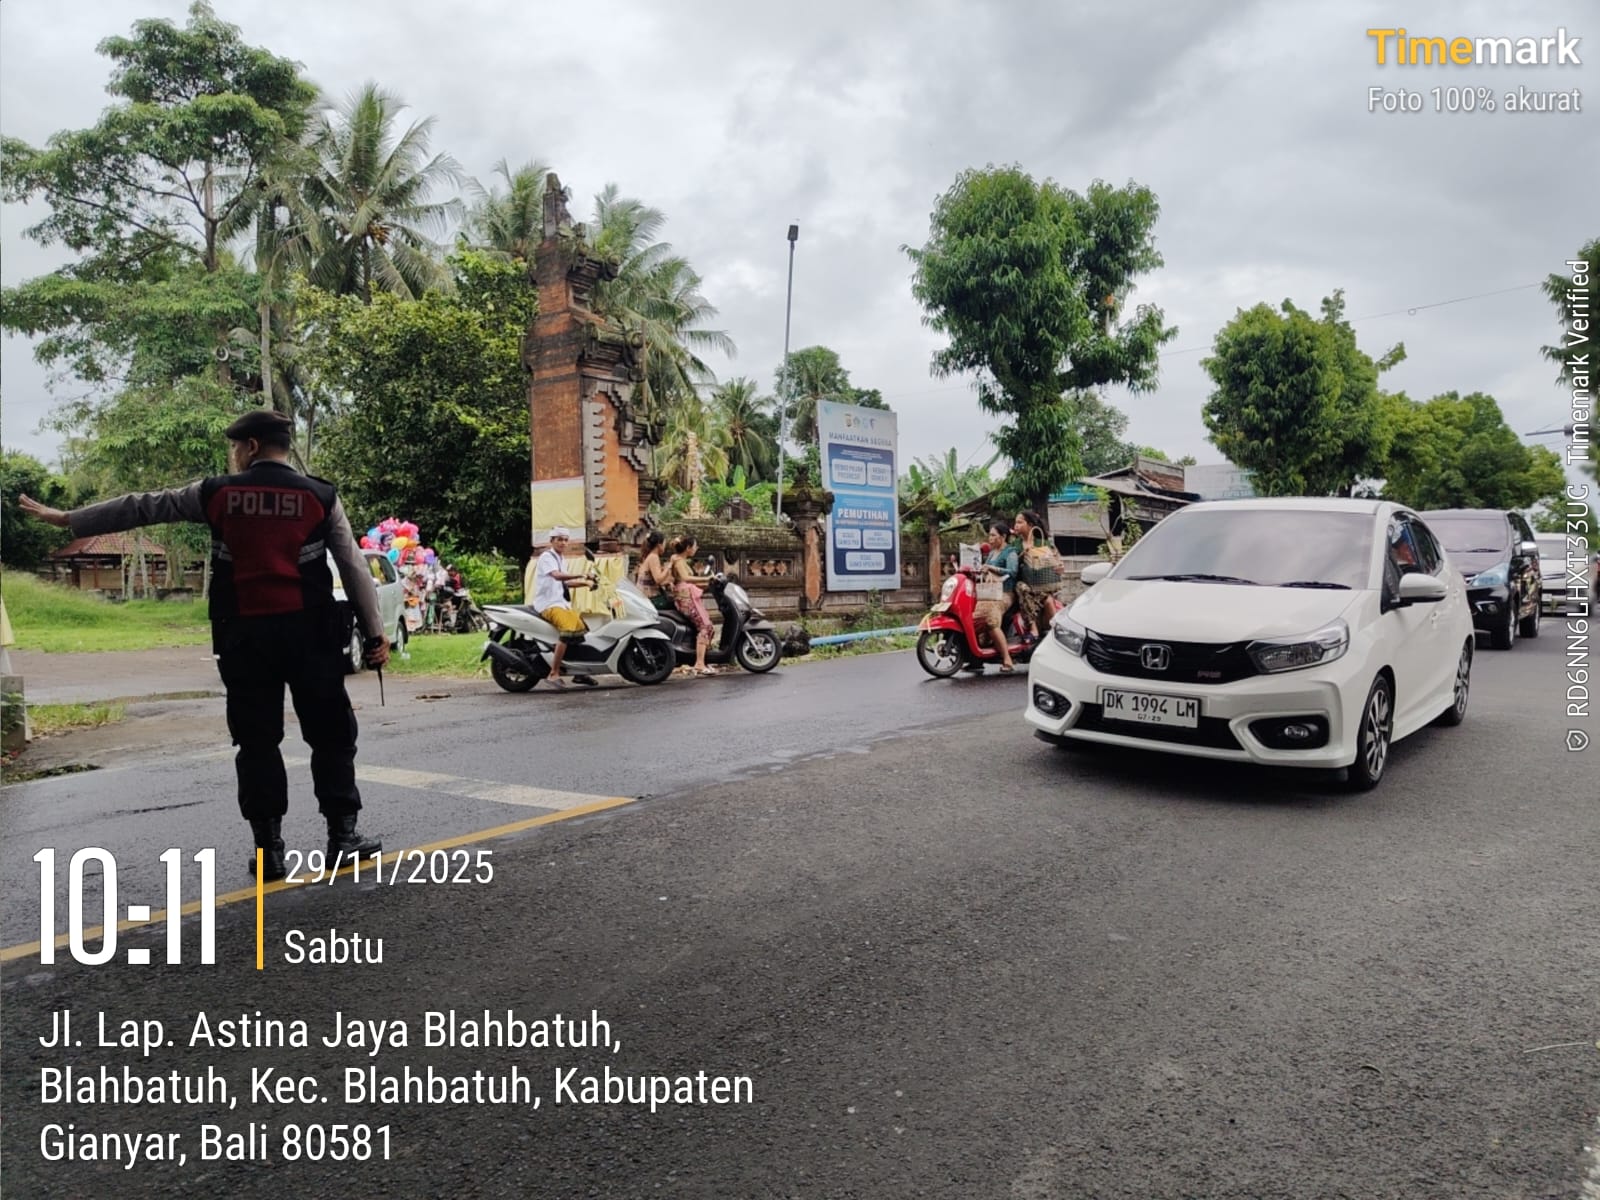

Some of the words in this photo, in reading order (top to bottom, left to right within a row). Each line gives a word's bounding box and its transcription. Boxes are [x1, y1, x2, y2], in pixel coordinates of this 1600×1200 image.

[226, 491, 304, 516] POLISI
[837, 508, 889, 521] PEMUTIHAN
[1106, 692, 1124, 710] DK
[1131, 696, 1168, 714] 1994
[1176, 701, 1196, 718] LM
